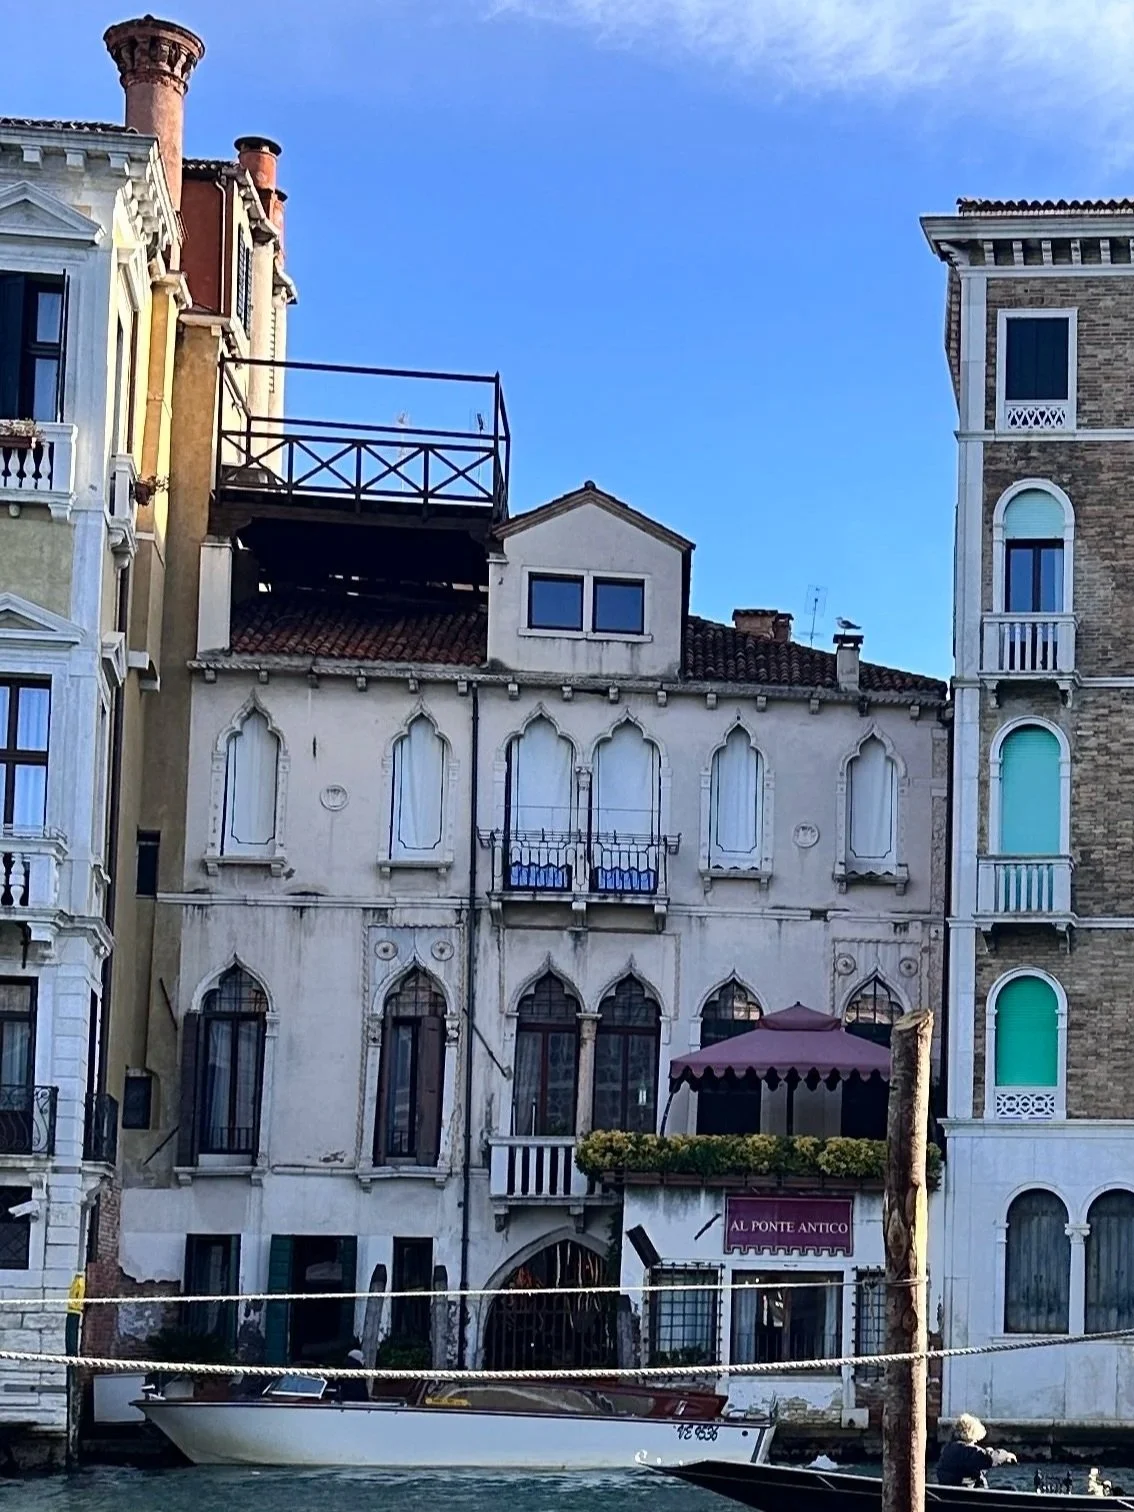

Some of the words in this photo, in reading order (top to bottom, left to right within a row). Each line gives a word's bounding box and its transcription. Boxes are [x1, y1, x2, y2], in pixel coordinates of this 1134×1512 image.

[730, 1220, 748, 1232] AL
[751, 1221, 795, 1233] PONTE
[798, 1222, 848, 1234] ANTICO
[677, 1424, 693, 1440] VE
